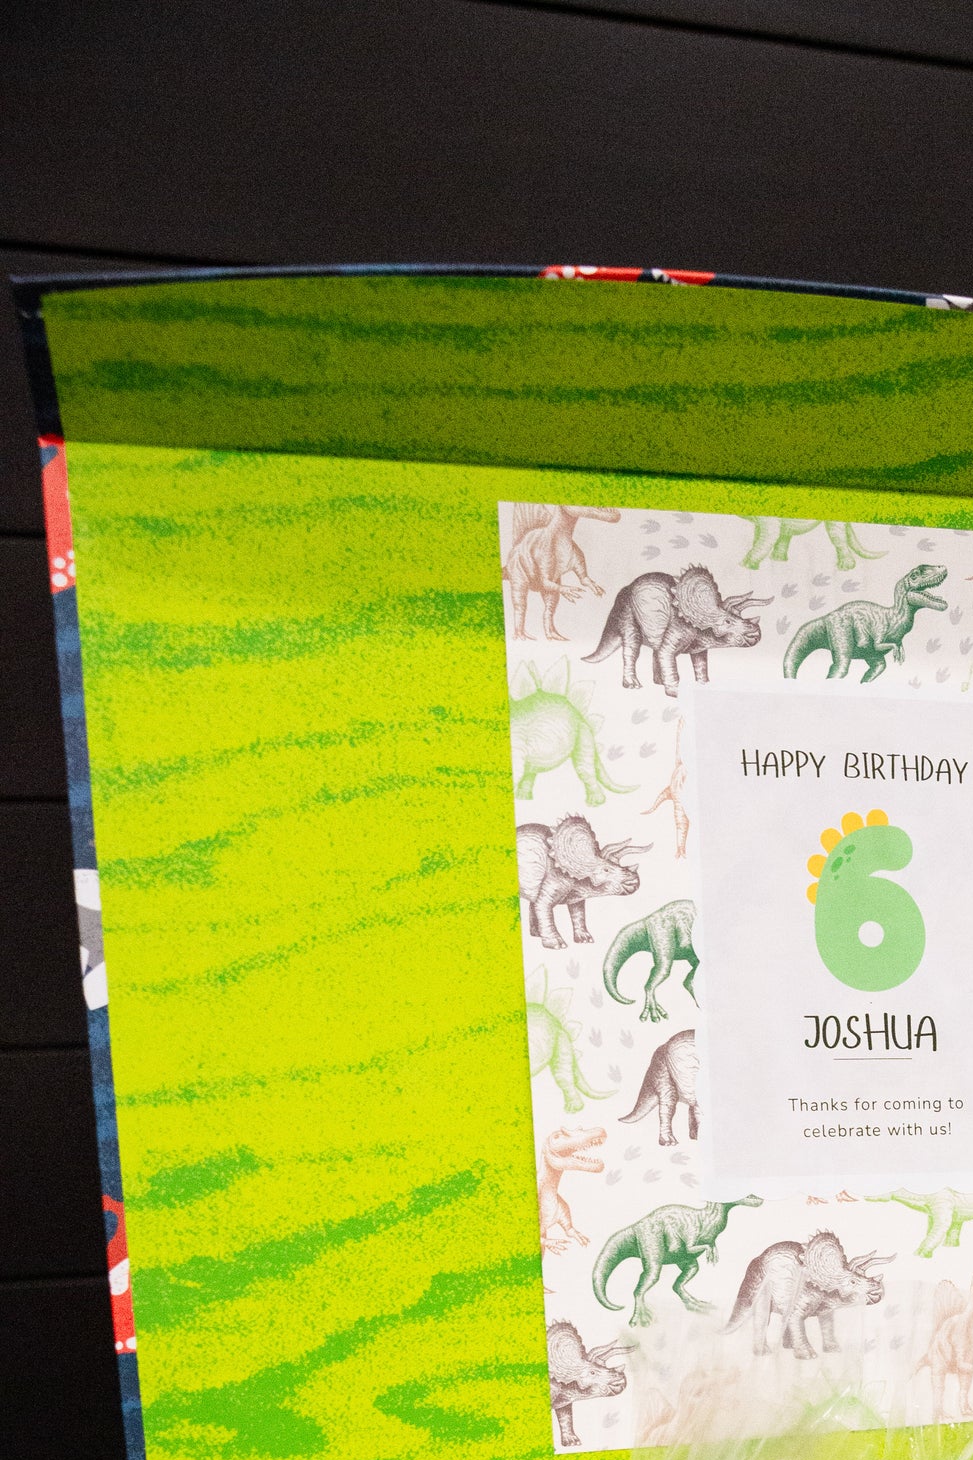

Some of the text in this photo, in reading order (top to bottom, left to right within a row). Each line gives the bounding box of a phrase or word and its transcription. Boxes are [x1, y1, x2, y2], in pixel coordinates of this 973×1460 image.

[740, 748, 969, 785] HAPPY BIRTHDAY
[810, 813, 926, 992] 6
[803, 1012, 938, 1053] JOSHUA
[787, 1097, 965, 1116] Thanks for coming to
[803, 1122, 952, 1138] celebrate with us!
